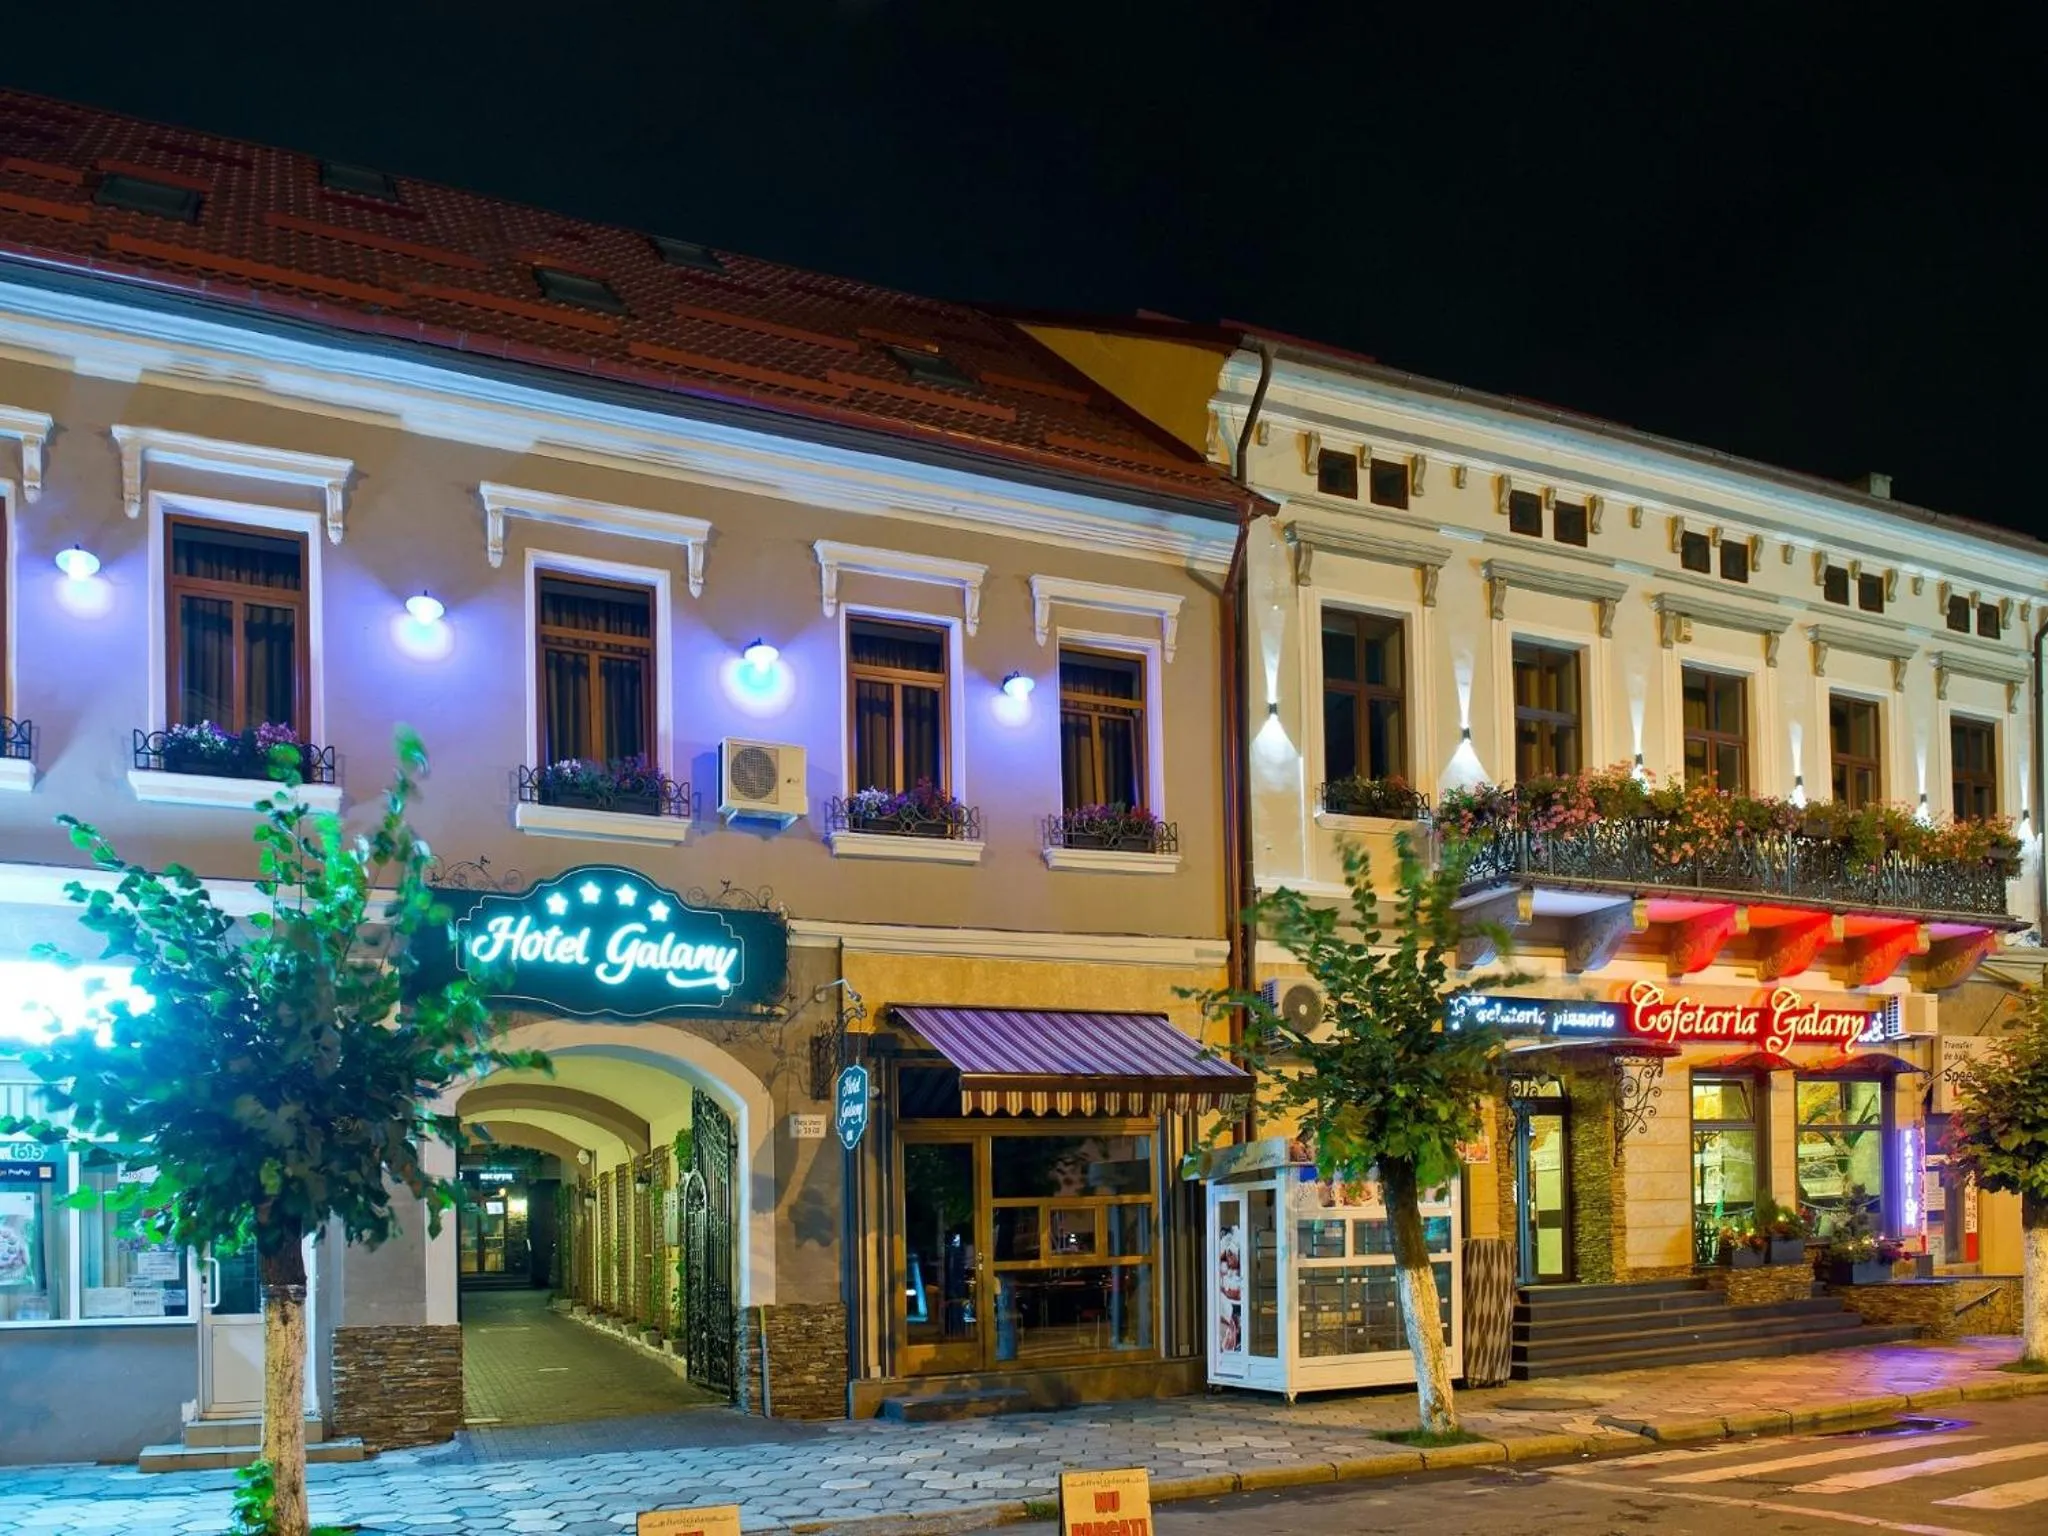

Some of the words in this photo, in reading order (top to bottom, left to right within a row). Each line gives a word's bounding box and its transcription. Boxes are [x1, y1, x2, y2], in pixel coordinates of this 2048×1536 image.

[472, 914, 591, 964] Hotel
[595, 922, 738, 991] Galany
[1630, 980, 1760, 1044] Cofetaria
[1765, 986, 1865, 1056] Galany
[1943, 1041, 1974, 1049] Transfer
[1903, 1129, 1917, 1228] FASHION
[1093, 1490, 1120, 1514] NU
